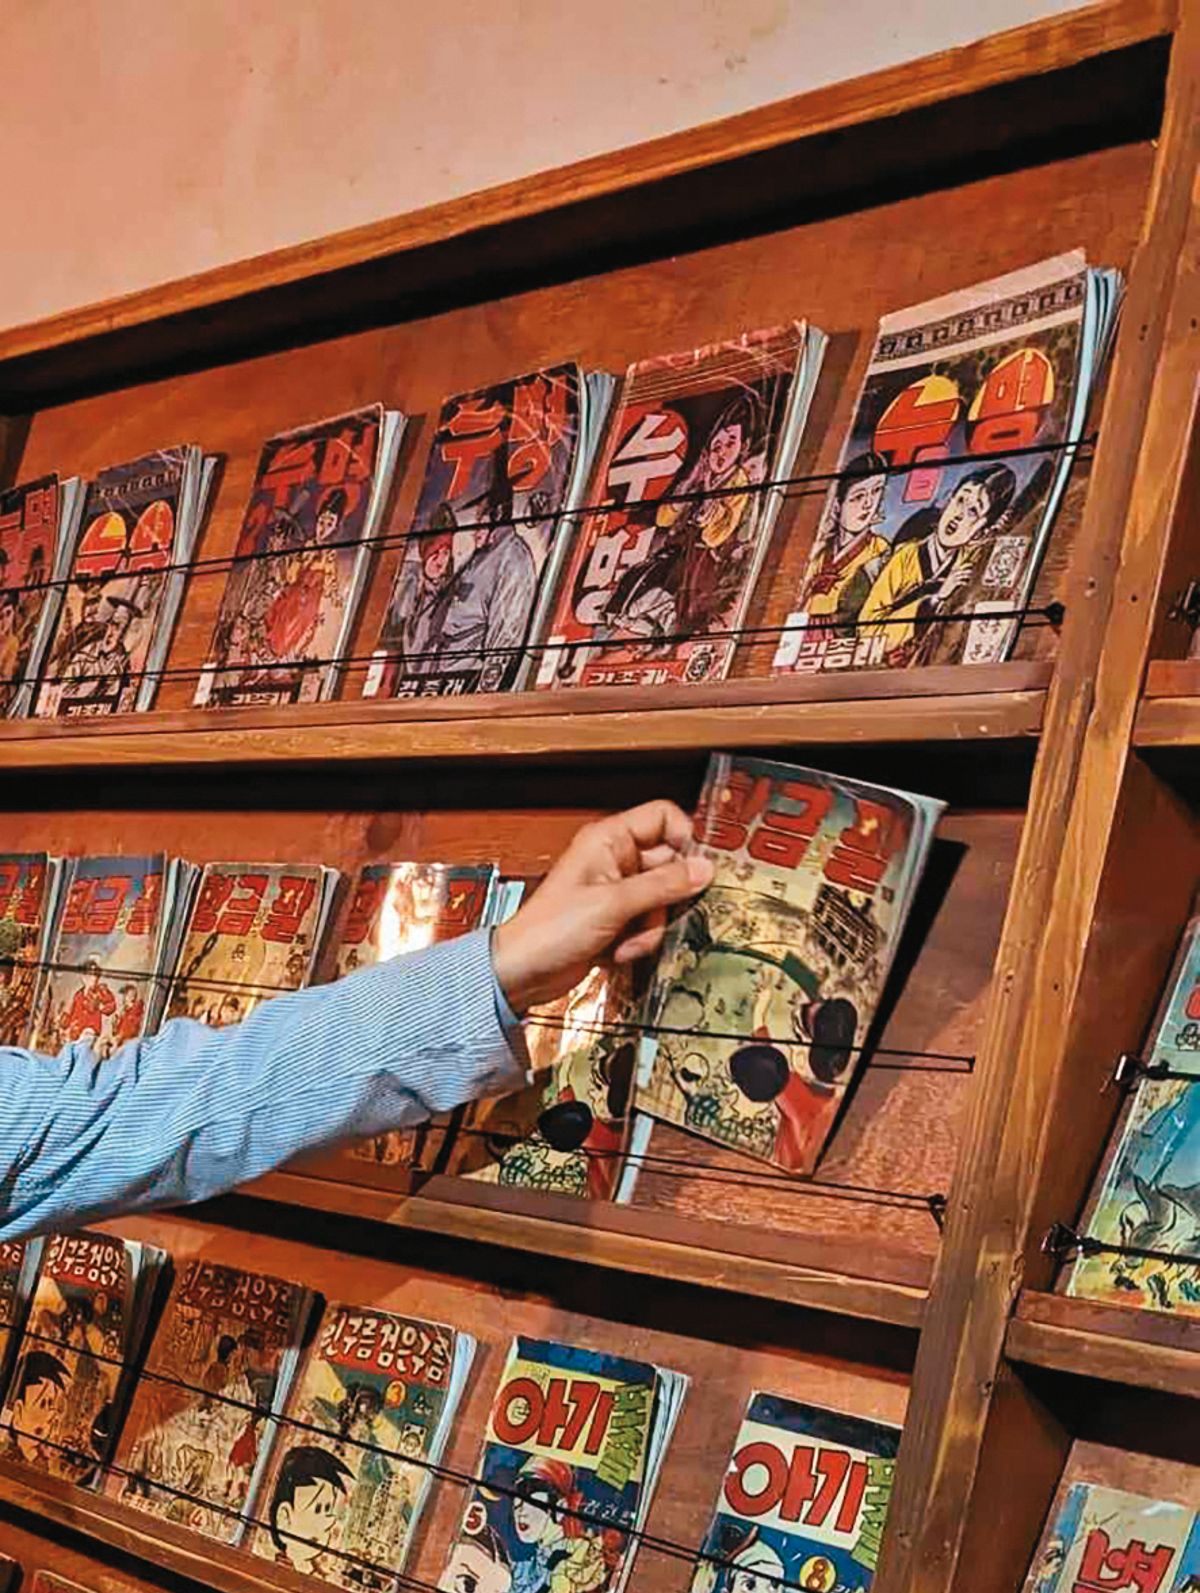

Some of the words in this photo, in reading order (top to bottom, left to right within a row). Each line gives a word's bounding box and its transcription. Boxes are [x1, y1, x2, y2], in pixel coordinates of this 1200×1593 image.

[795, 637, 888, 670] 김종래
[492, 1376, 613, 1456] 아기
[724, 1441, 868, 1533] 아기
[466, 1504, 484, 1533] 5
[805, 1558, 828, 1593] 8
